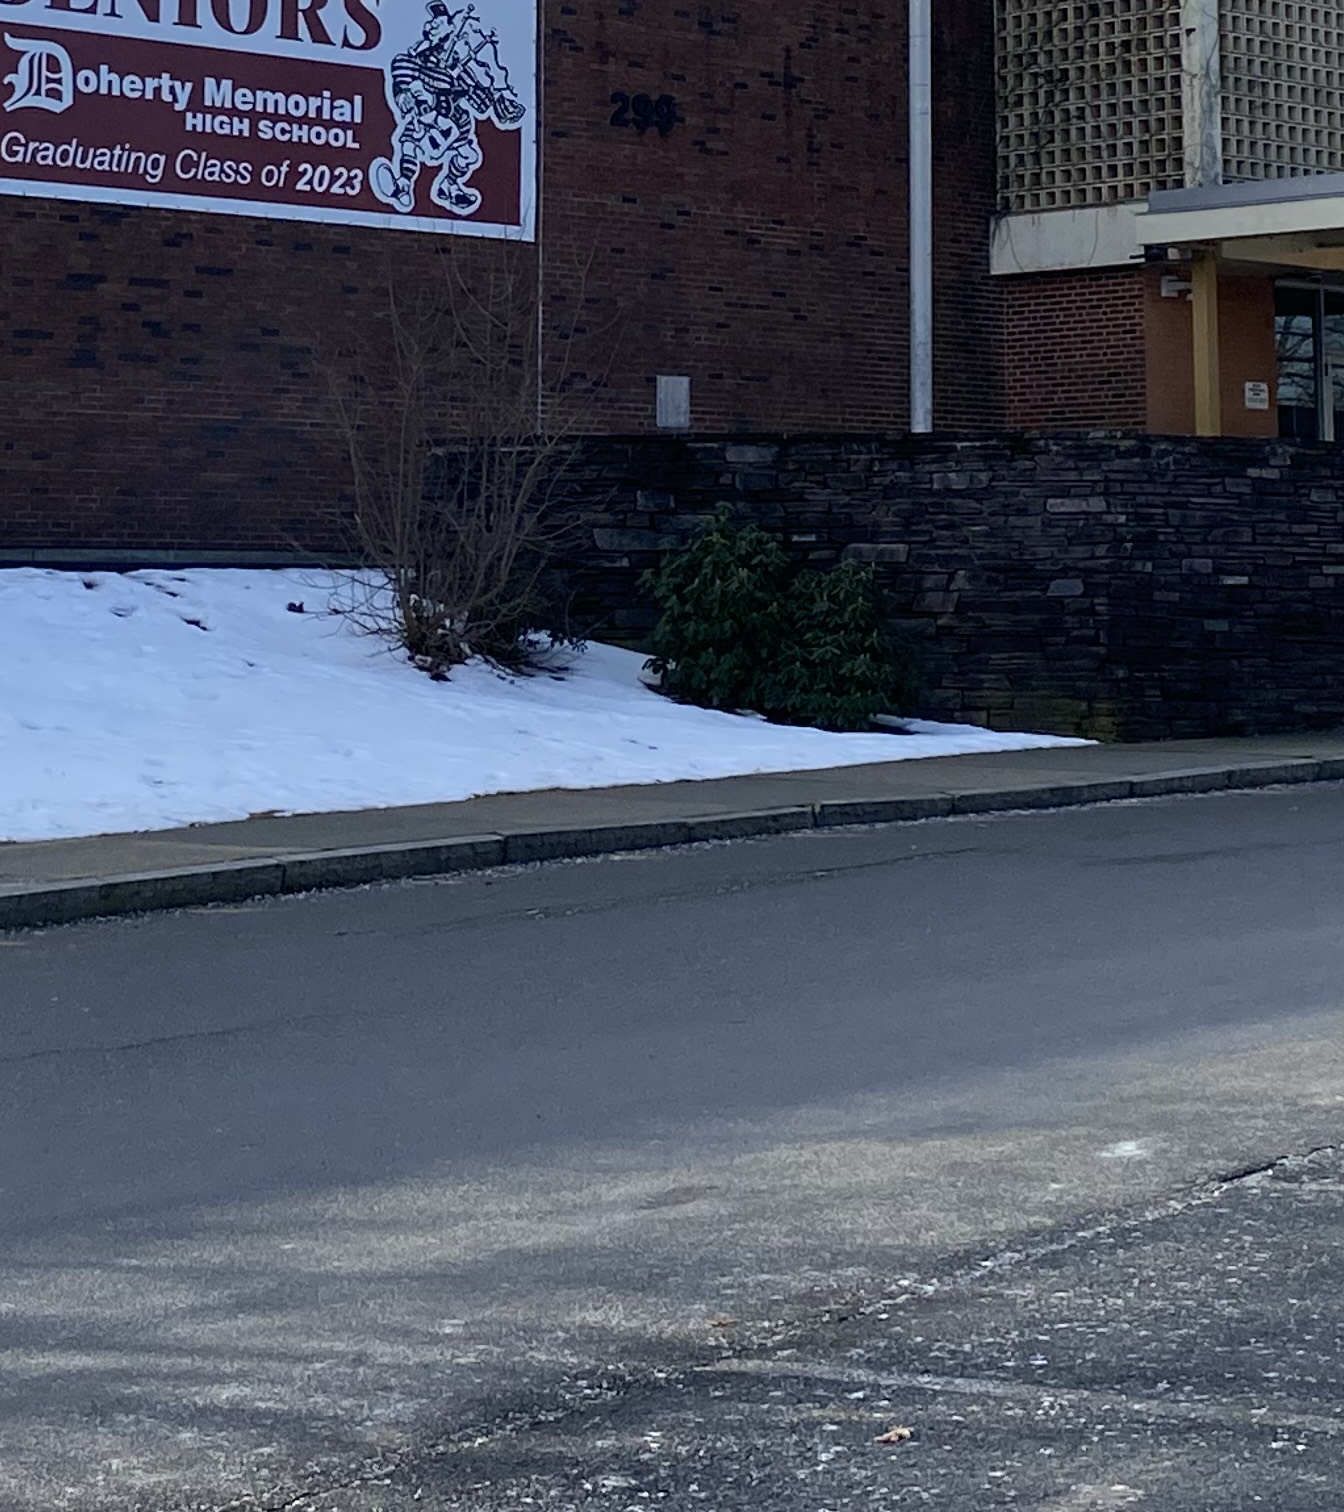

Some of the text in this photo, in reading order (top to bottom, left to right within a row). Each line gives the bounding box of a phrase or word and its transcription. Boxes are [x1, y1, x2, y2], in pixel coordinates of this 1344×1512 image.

[2, 32, 364, 124] Doherty Memorial
[184, 111, 361, 150] HIGH SCHOOL
[0, 131, 364, 197] Graduating Class of 2023
